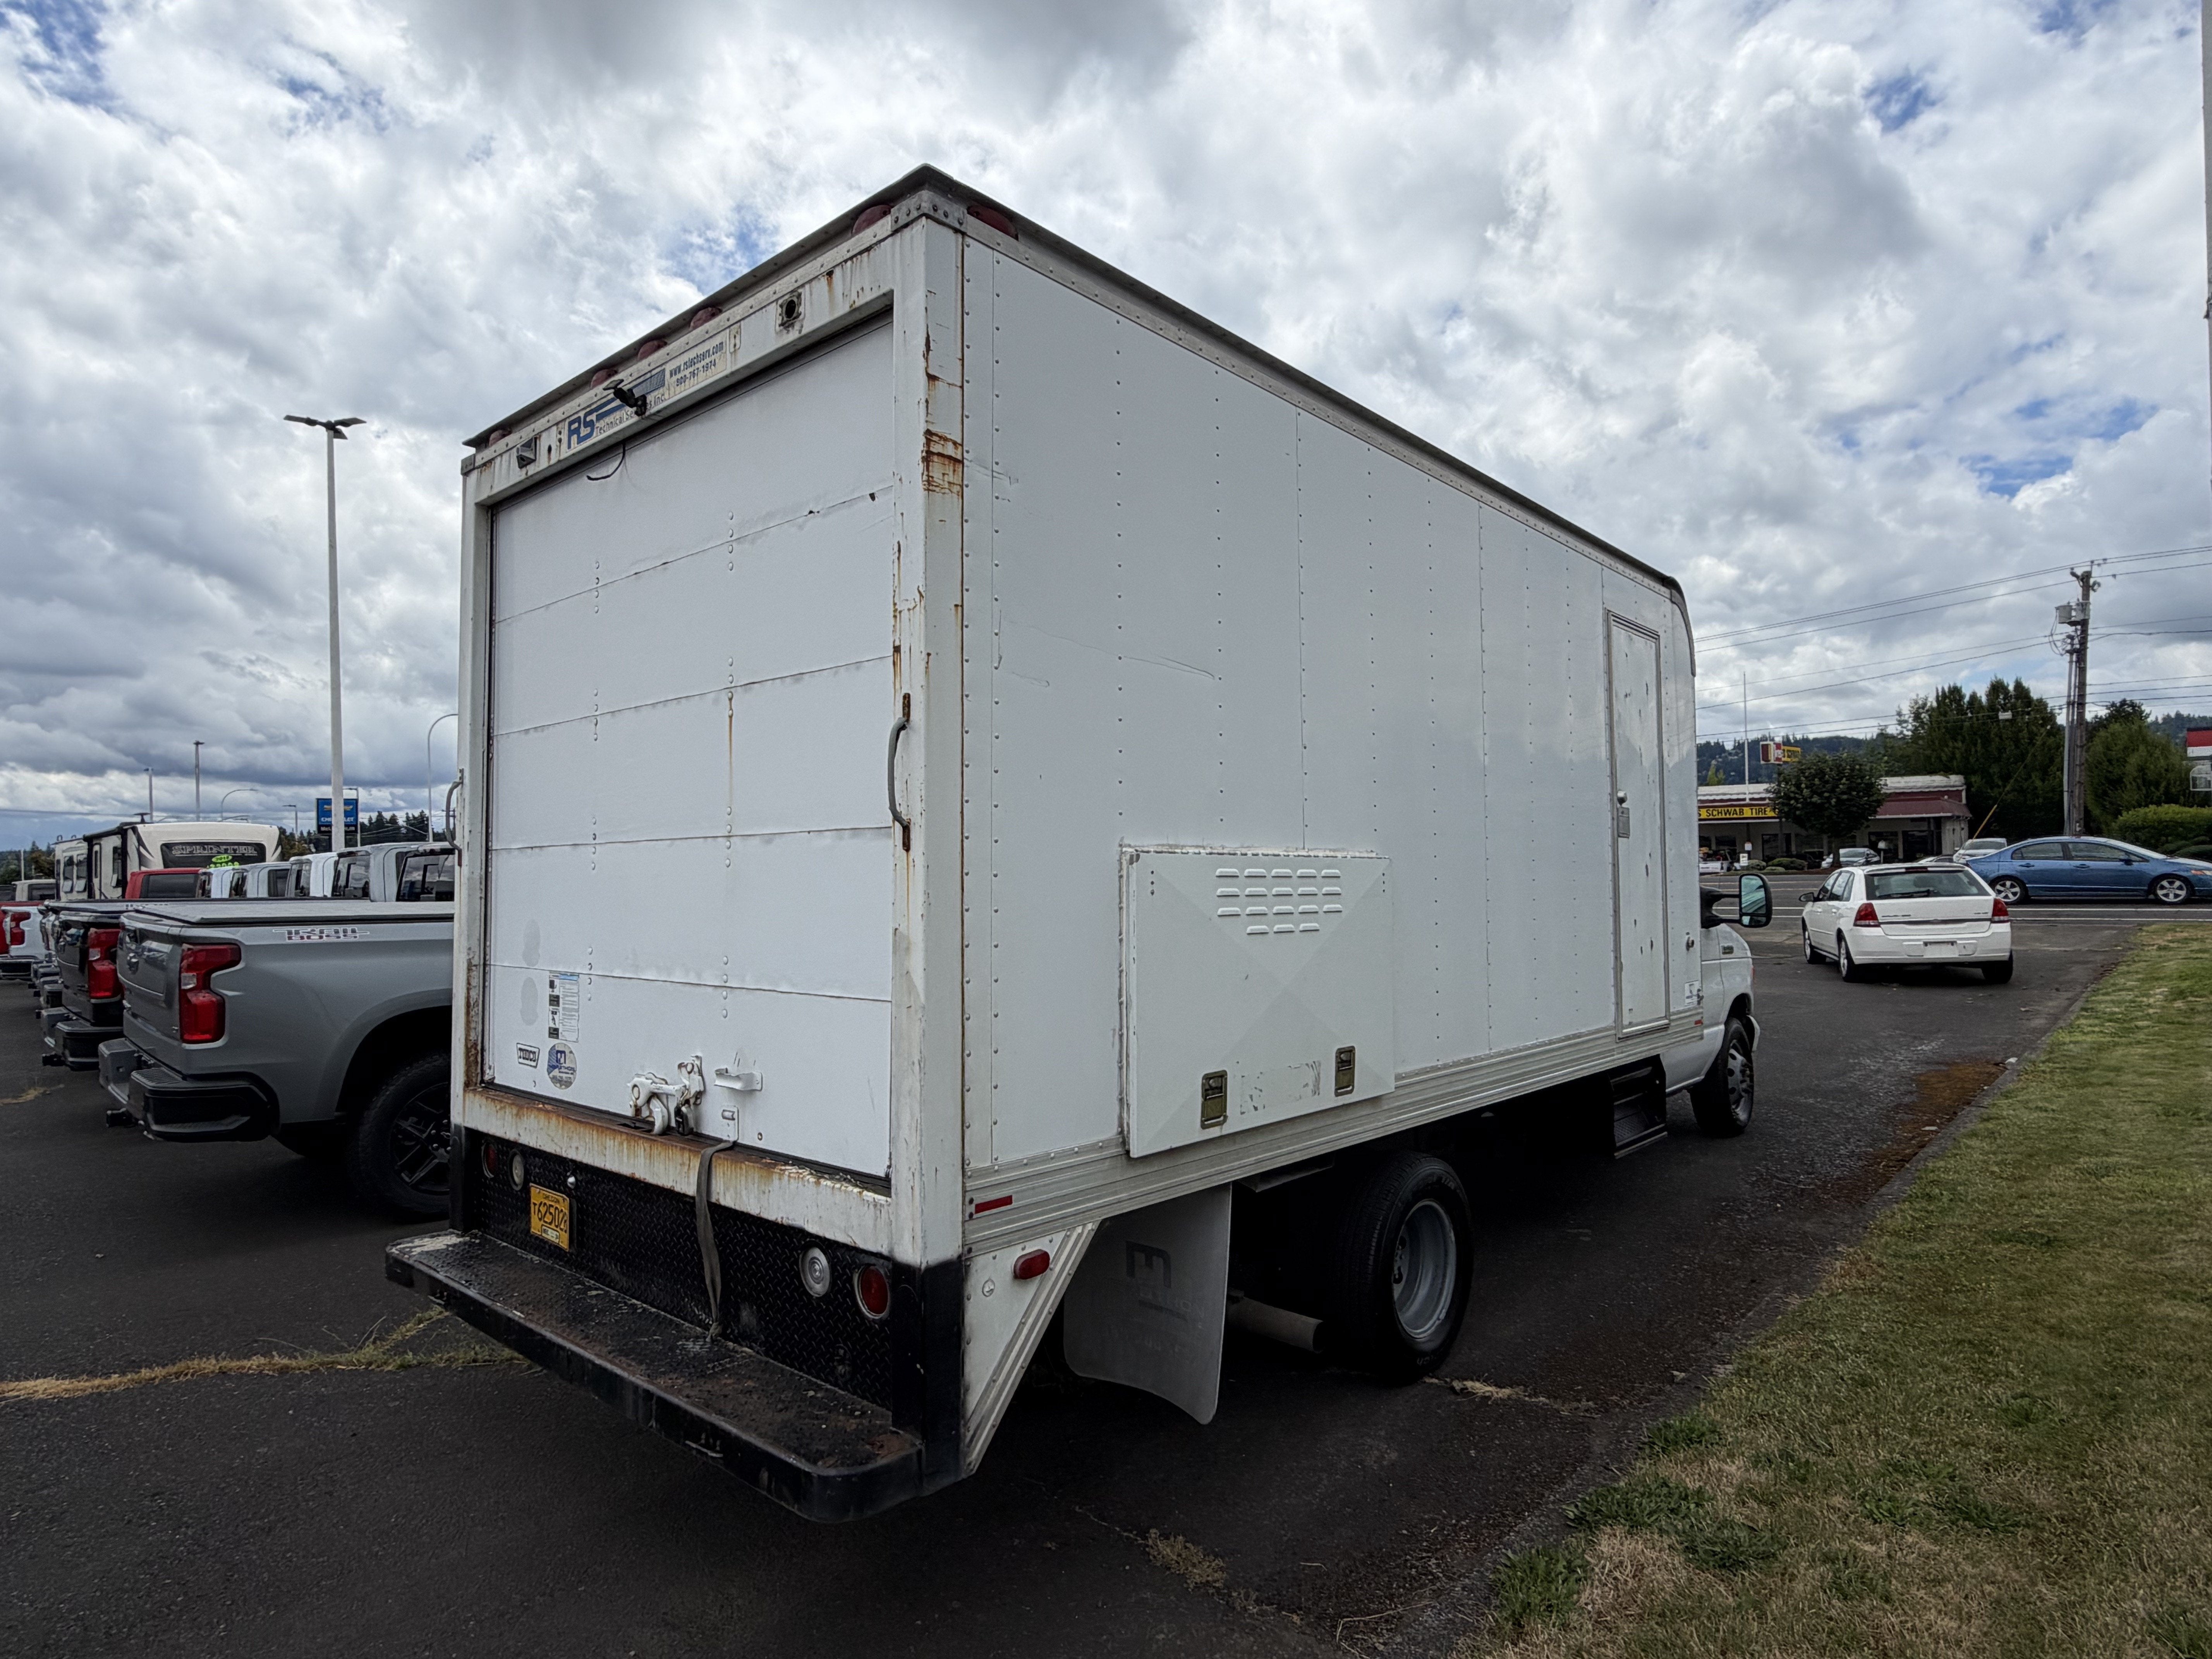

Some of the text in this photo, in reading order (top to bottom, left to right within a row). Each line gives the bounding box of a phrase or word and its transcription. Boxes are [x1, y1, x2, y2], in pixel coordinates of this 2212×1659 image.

[669, 341, 723, 378] www.rstechserv.com
[676, 358, 716, 386] 800-767-1974
[567, 409, 596, 450] RS
[595, 412, 624, 438] Technical
[624, 400, 652, 420] Sees
[1705, 808, 1744, 817] SCHWAB
[1749, 807, 1769, 816] TIRE
[172, 845, 257, 854] SPRINTER
[273, 927, 370, 935] TRAIL
